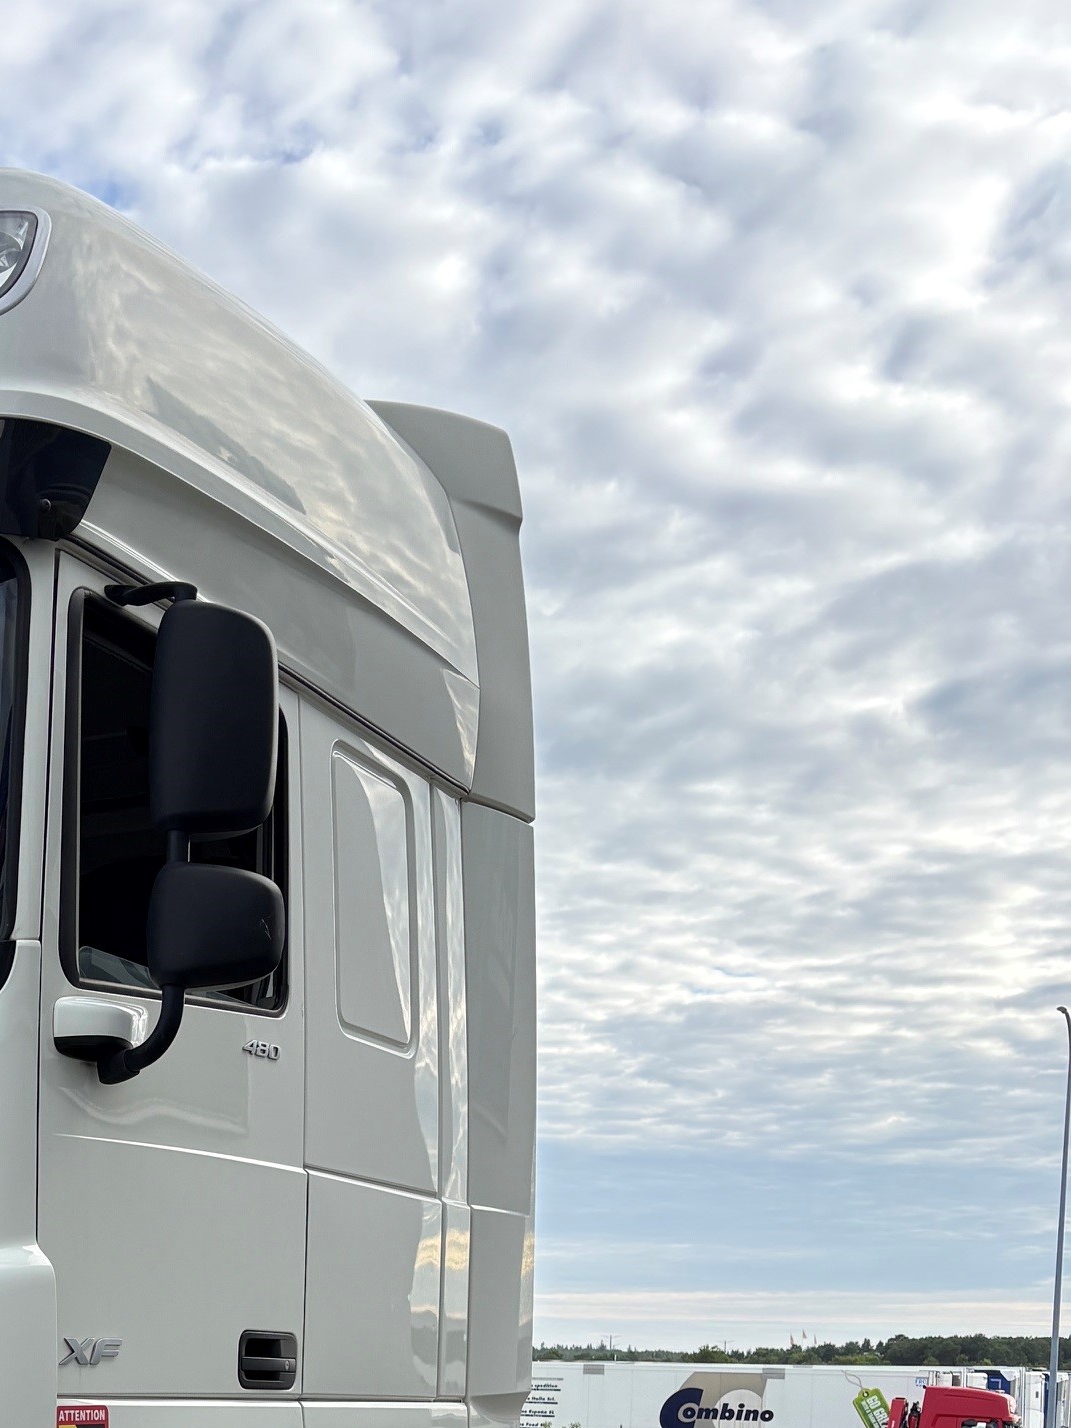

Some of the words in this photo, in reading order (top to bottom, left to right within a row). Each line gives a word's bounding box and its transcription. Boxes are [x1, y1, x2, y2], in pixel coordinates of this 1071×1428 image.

[242, 1040, 281, 1060] 480
[59, 1337, 122, 1365] XF
[59, 1409, 105, 1422] ATTENTION
